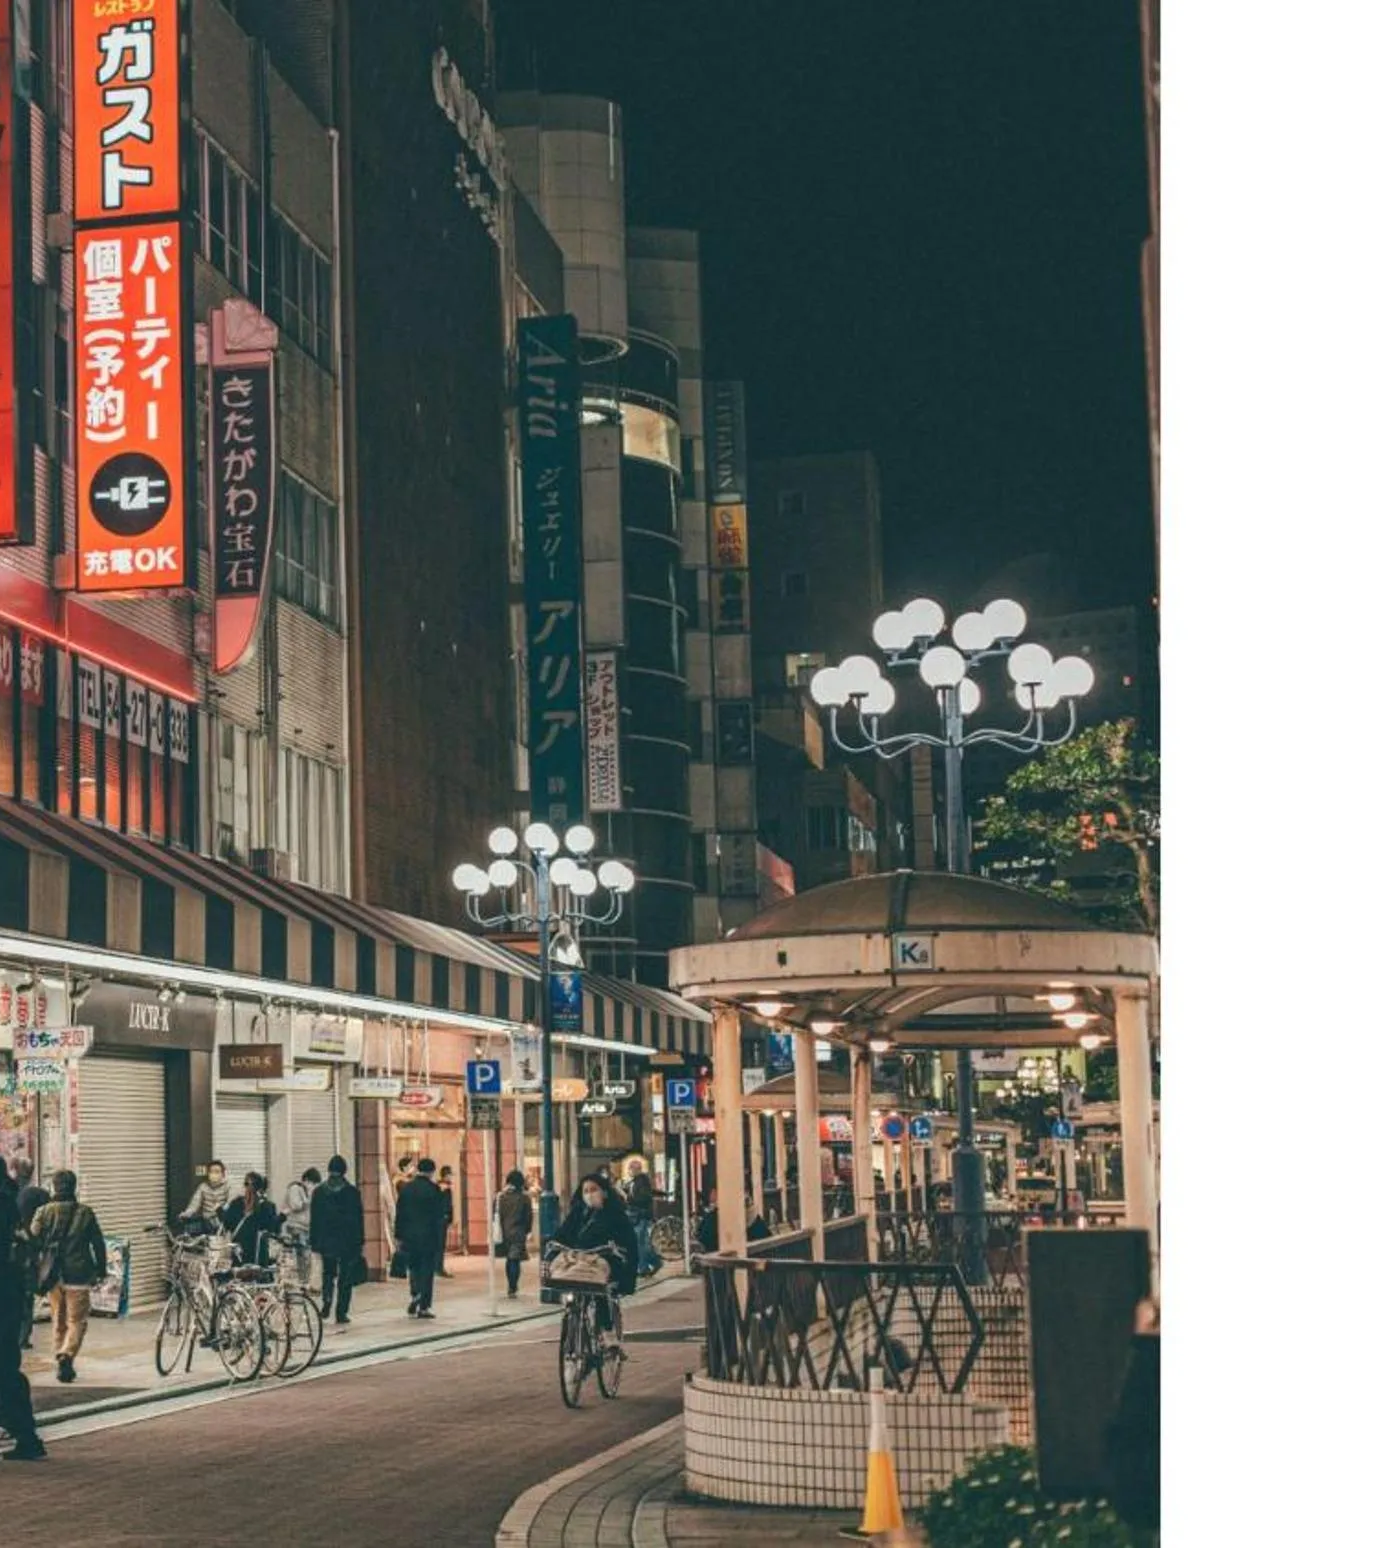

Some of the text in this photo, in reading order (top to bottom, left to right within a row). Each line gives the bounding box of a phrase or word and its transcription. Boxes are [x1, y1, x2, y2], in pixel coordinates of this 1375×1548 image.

[95, 15, 155, 211] ガスト
[130, 236, 172, 442] パーティー
[222, 375, 258, 588] きたがわ宝石
[83, 546, 178, 577] 充電OK
[533, 600, 577, 756] アリア
[476, 1063, 495, 1092] P
[675, 1083, 690, 1104] P
